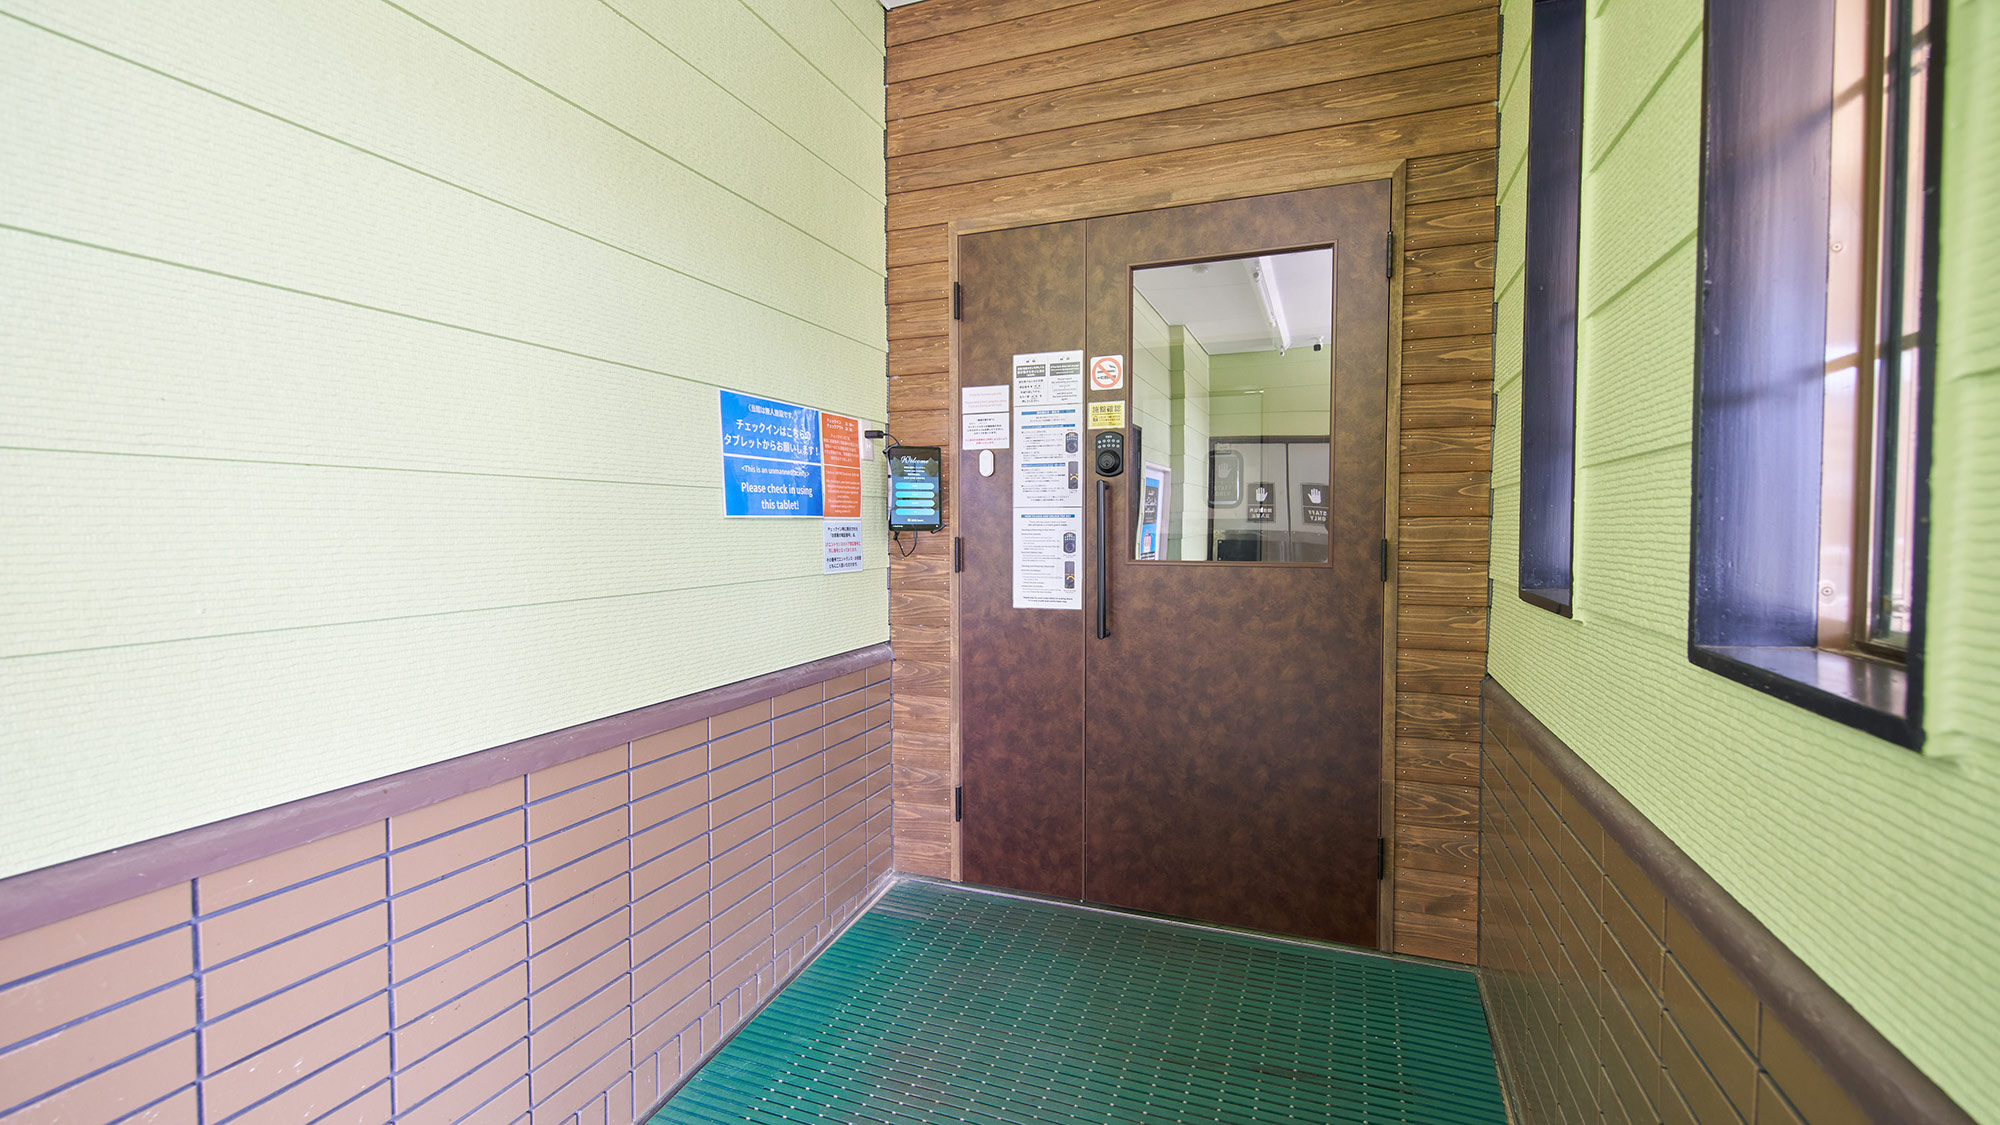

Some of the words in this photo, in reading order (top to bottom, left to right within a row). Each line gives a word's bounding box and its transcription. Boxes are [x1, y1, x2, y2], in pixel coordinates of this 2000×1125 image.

[736, 419, 811, 440] チェックインはこちらの
[900, 455, 929, 464] Welcome
[741, 481, 766, 493] Please
[766, 483, 788, 494] check
[788, 484, 796, 495] in
[796, 485, 813, 498] using
[761, 499, 776, 510] this
[776, 499, 800, 510] tablet!
